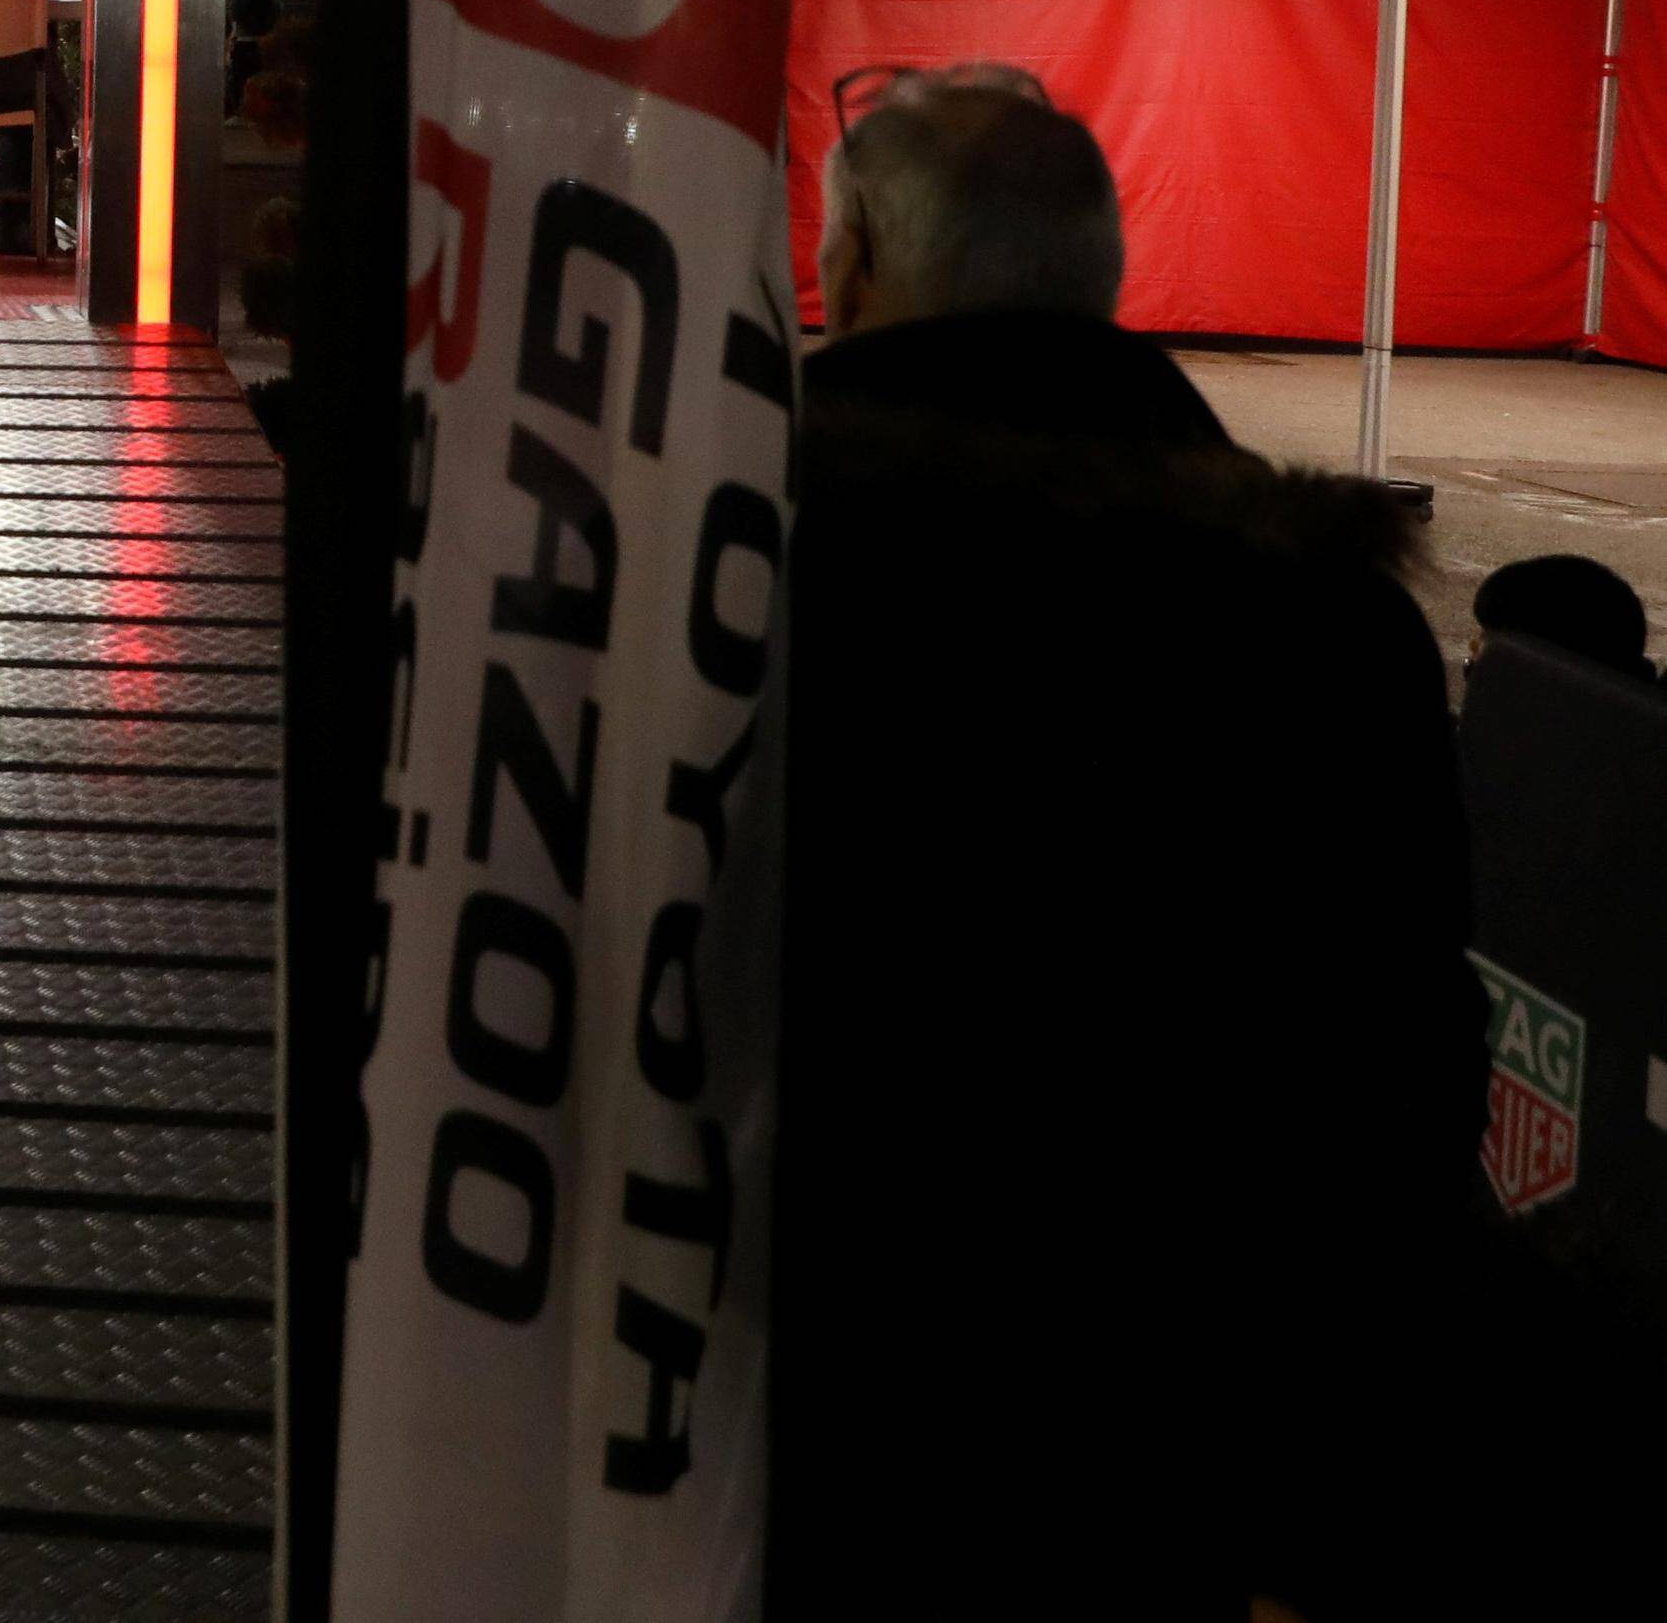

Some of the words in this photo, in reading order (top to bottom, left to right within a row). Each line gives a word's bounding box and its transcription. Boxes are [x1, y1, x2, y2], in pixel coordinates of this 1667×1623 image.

[424, 174, 678, 1328] GAZOO
[604, 274, 798, 1496] TOYOTA
[1482, 1078, 1571, 1197] UER
